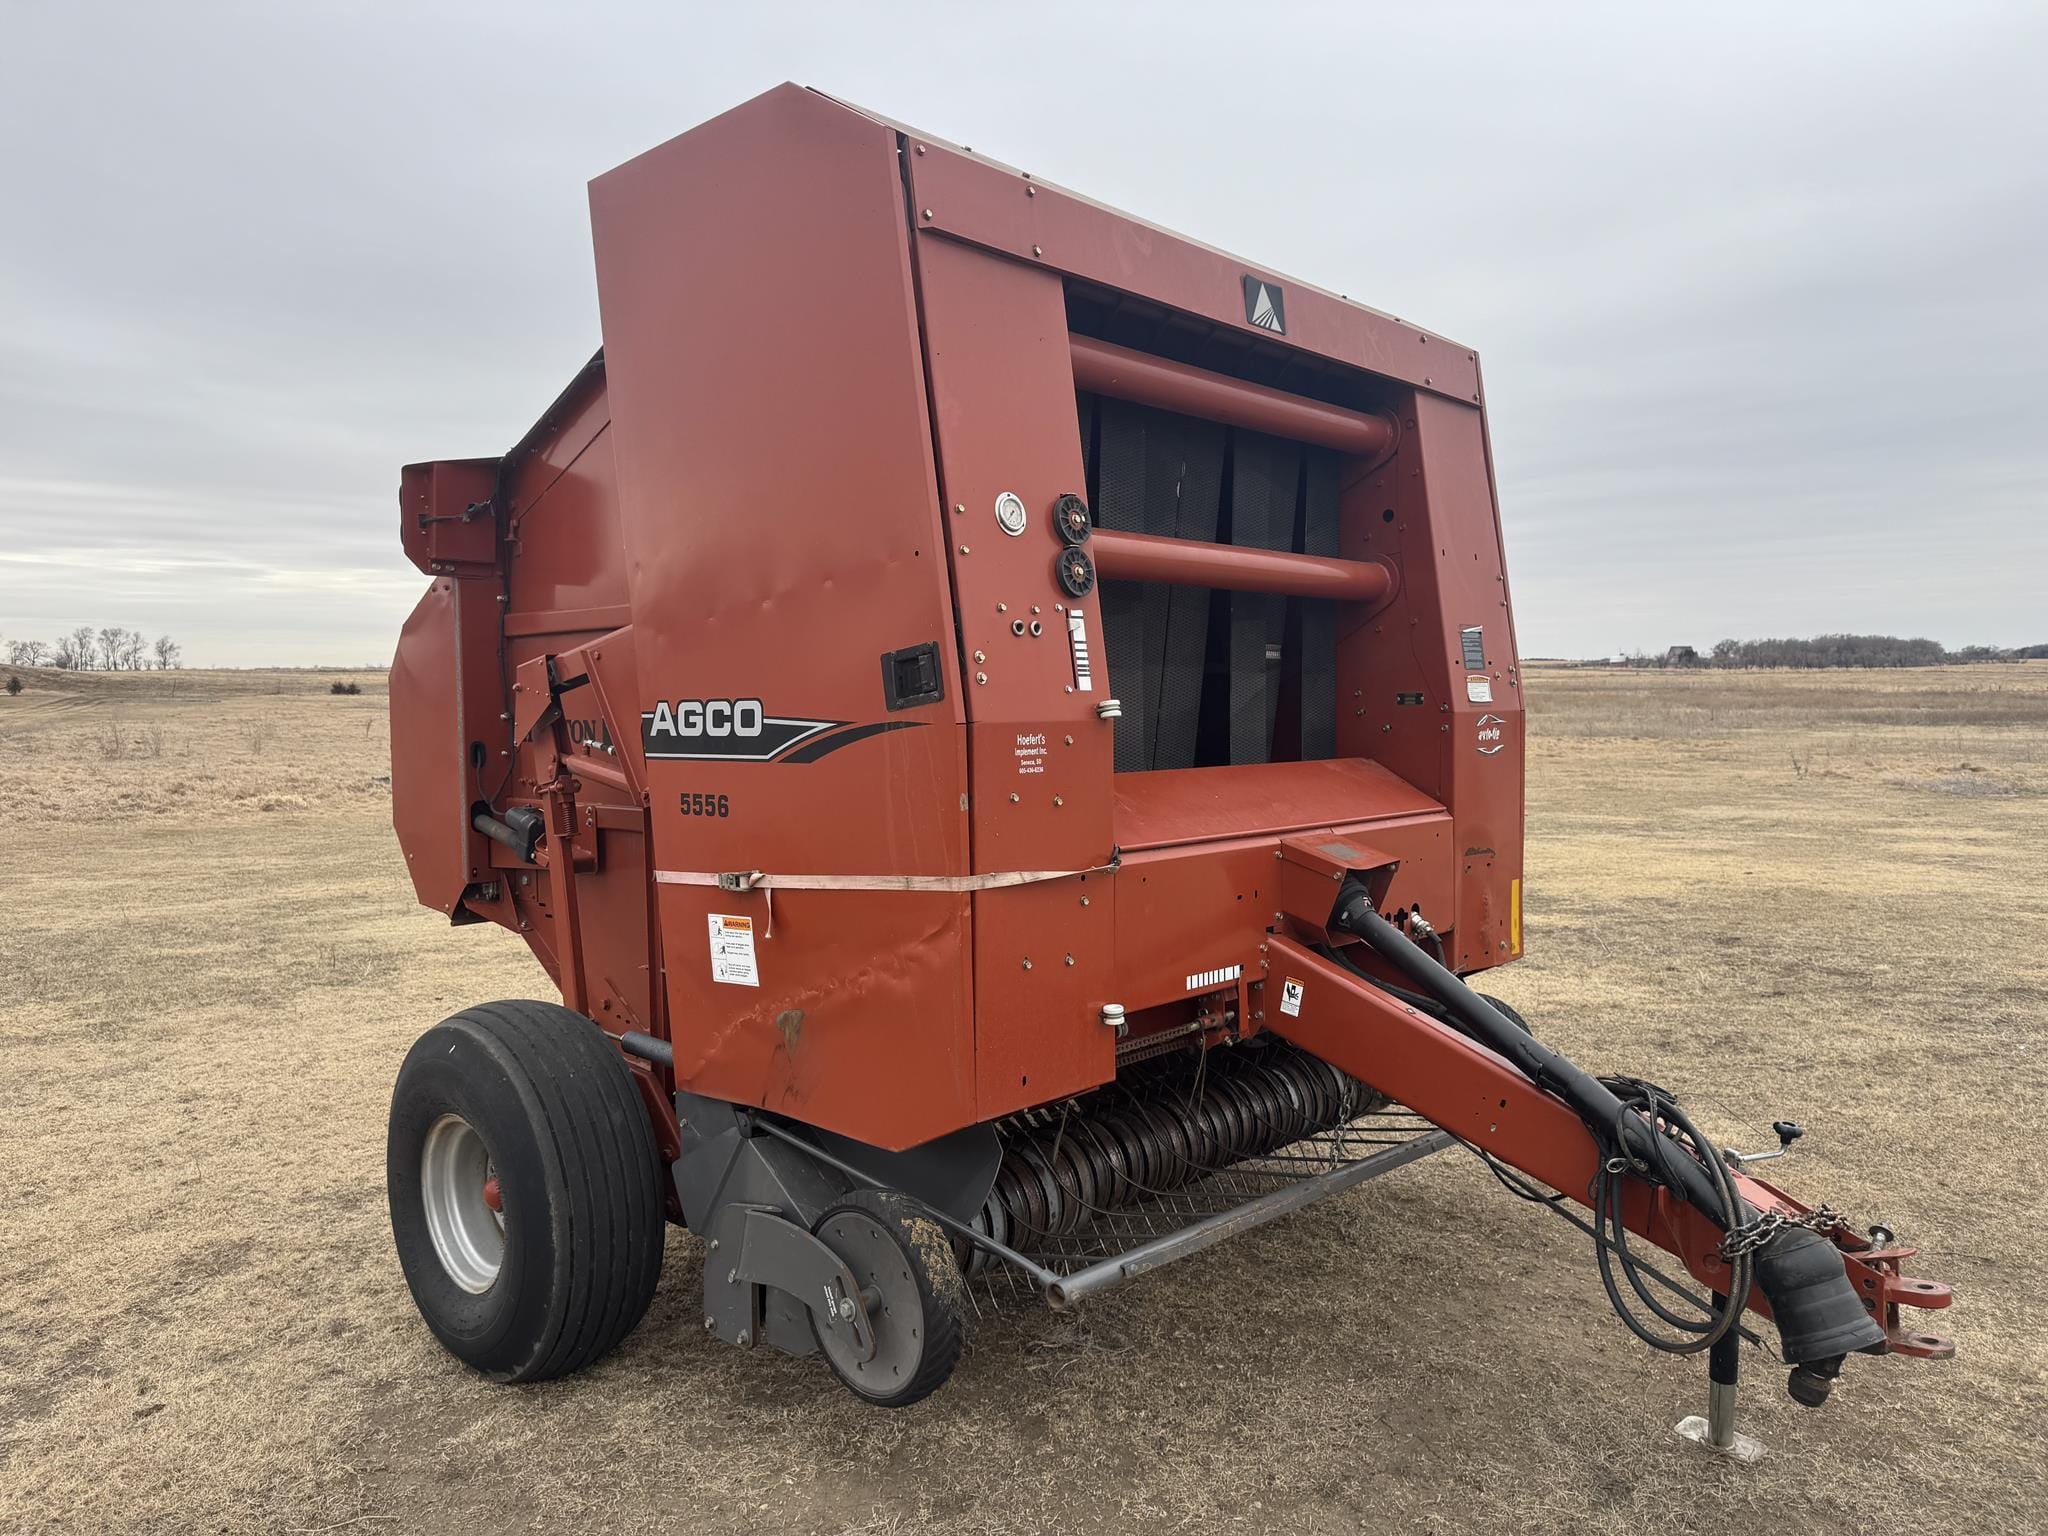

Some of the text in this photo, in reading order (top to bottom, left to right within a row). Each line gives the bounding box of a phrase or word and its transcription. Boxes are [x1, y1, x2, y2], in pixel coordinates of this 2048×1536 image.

[650, 699, 762, 737] AGCO
[1017, 733, 1046, 746] Hoefert's
[1014, 747, 1039, 757] Implement
[680, 793, 729, 818] 5556
